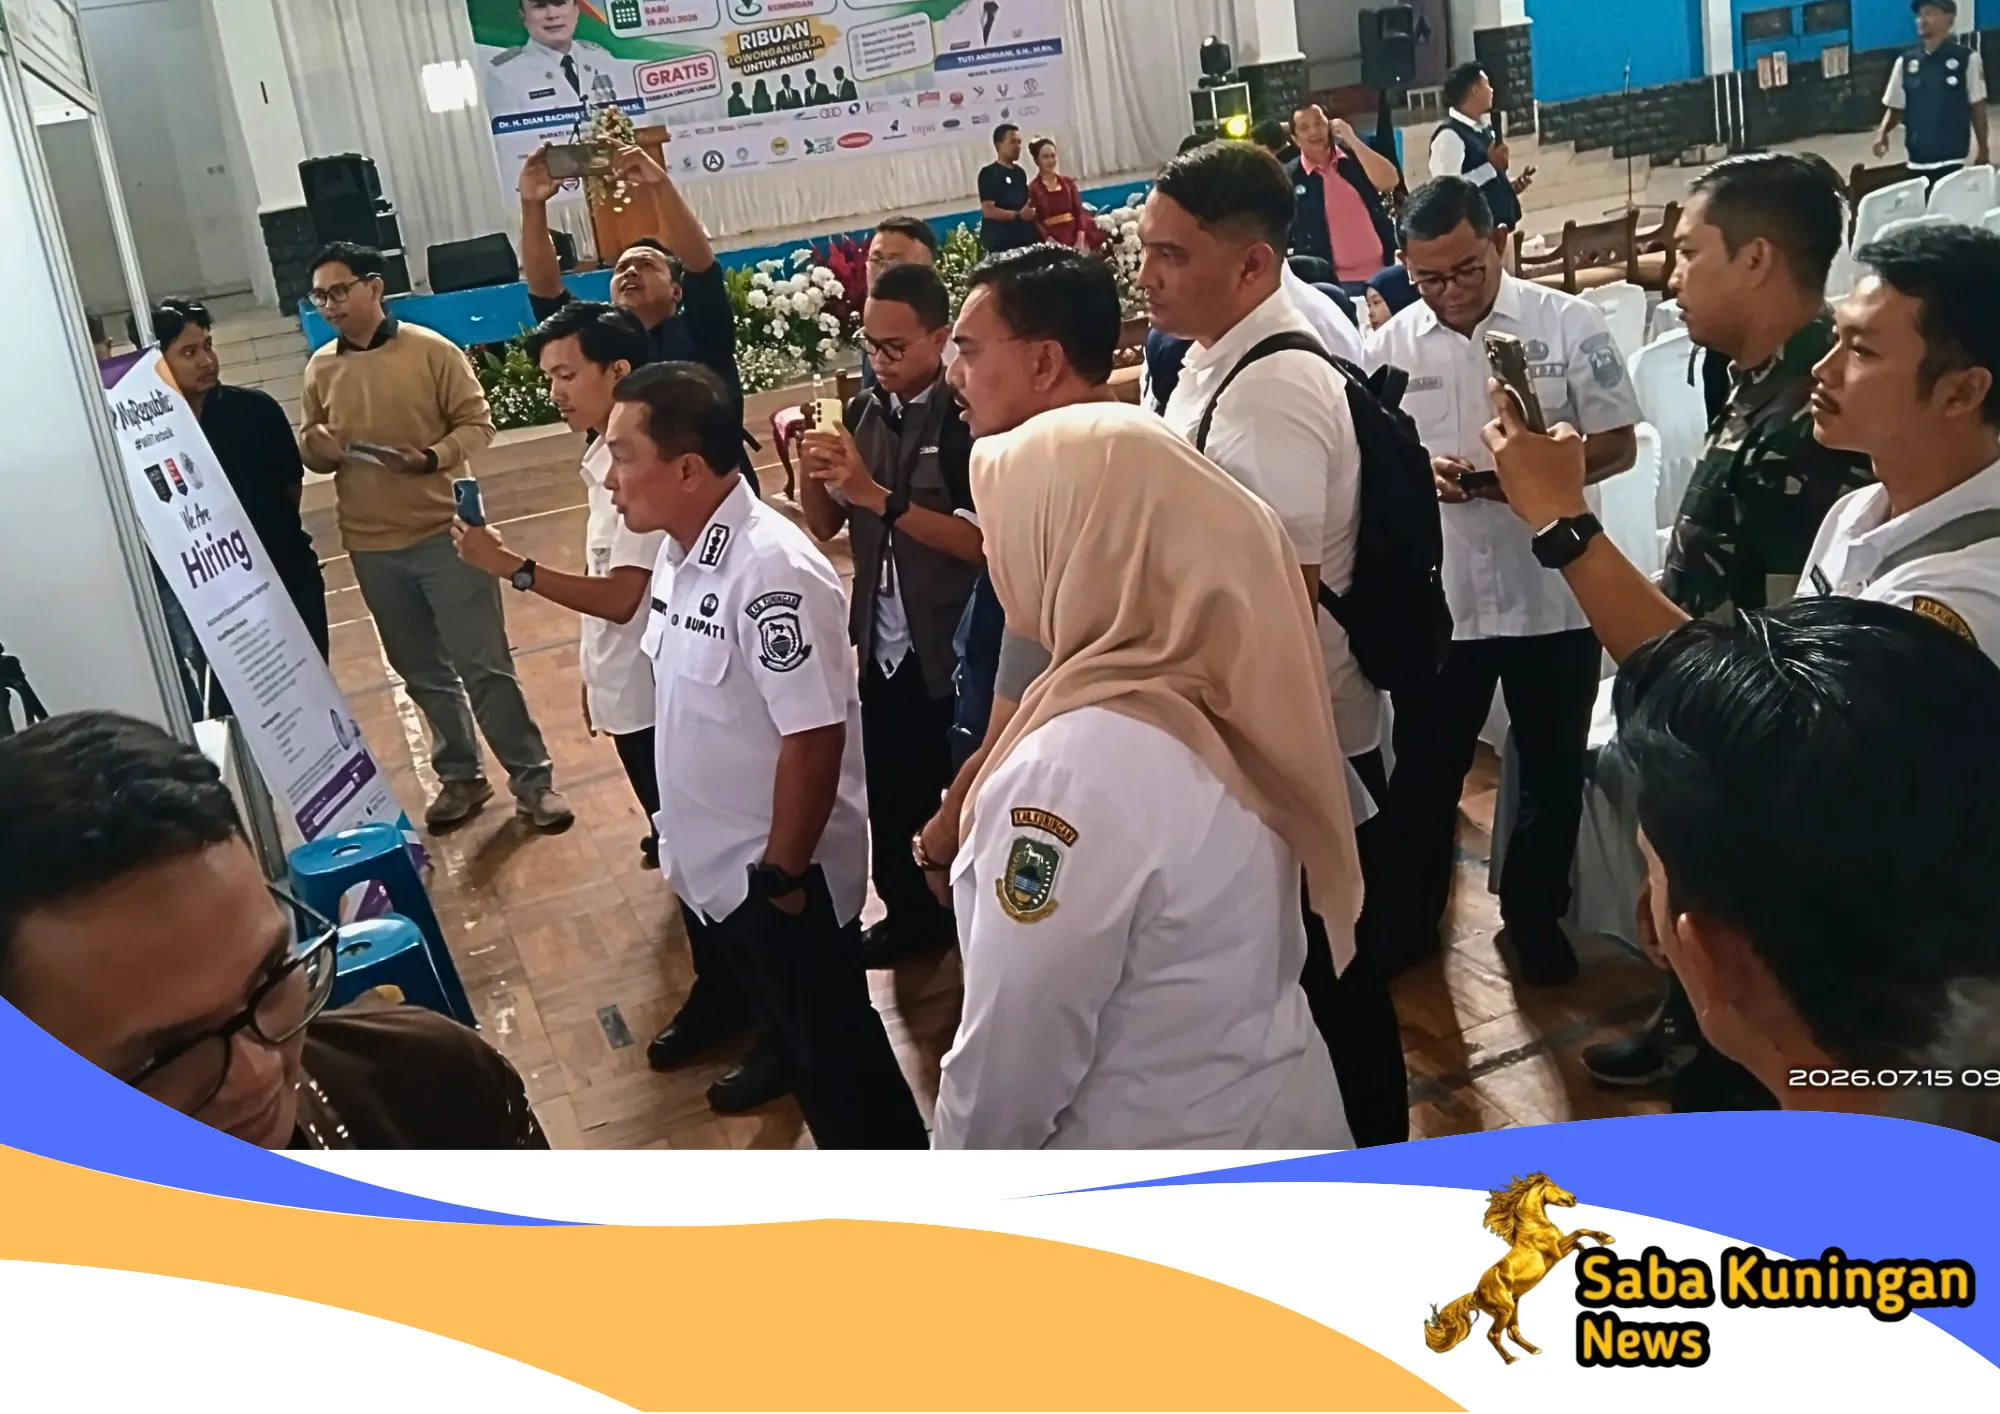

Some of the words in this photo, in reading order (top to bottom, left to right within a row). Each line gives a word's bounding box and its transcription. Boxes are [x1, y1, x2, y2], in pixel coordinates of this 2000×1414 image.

[738, 21, 809, 50] RIBUAN
[729, 45, 791, 66] LOWONGAN
[791, 36, 824, 51] KERJA
[743, 57, 778, 74] UNTUK
[780, 49, 812, 66] ANDA!
[957, 55, 974, 64] TUTI
[646, 62, 709, 86] GRATIS
[674, 88, 695, 97] UNTUK
[498, 121, 511, 129] Dr.
[522, 117, 543, 126] DIAN
[115, 389, 174, 431] MyRepublic
[179, 504, 197, 533] We
[194, 502, 212, 528] Are
[180, 529, 253, 589] Hiring
[685, 615, 725, 640] BUPATI
